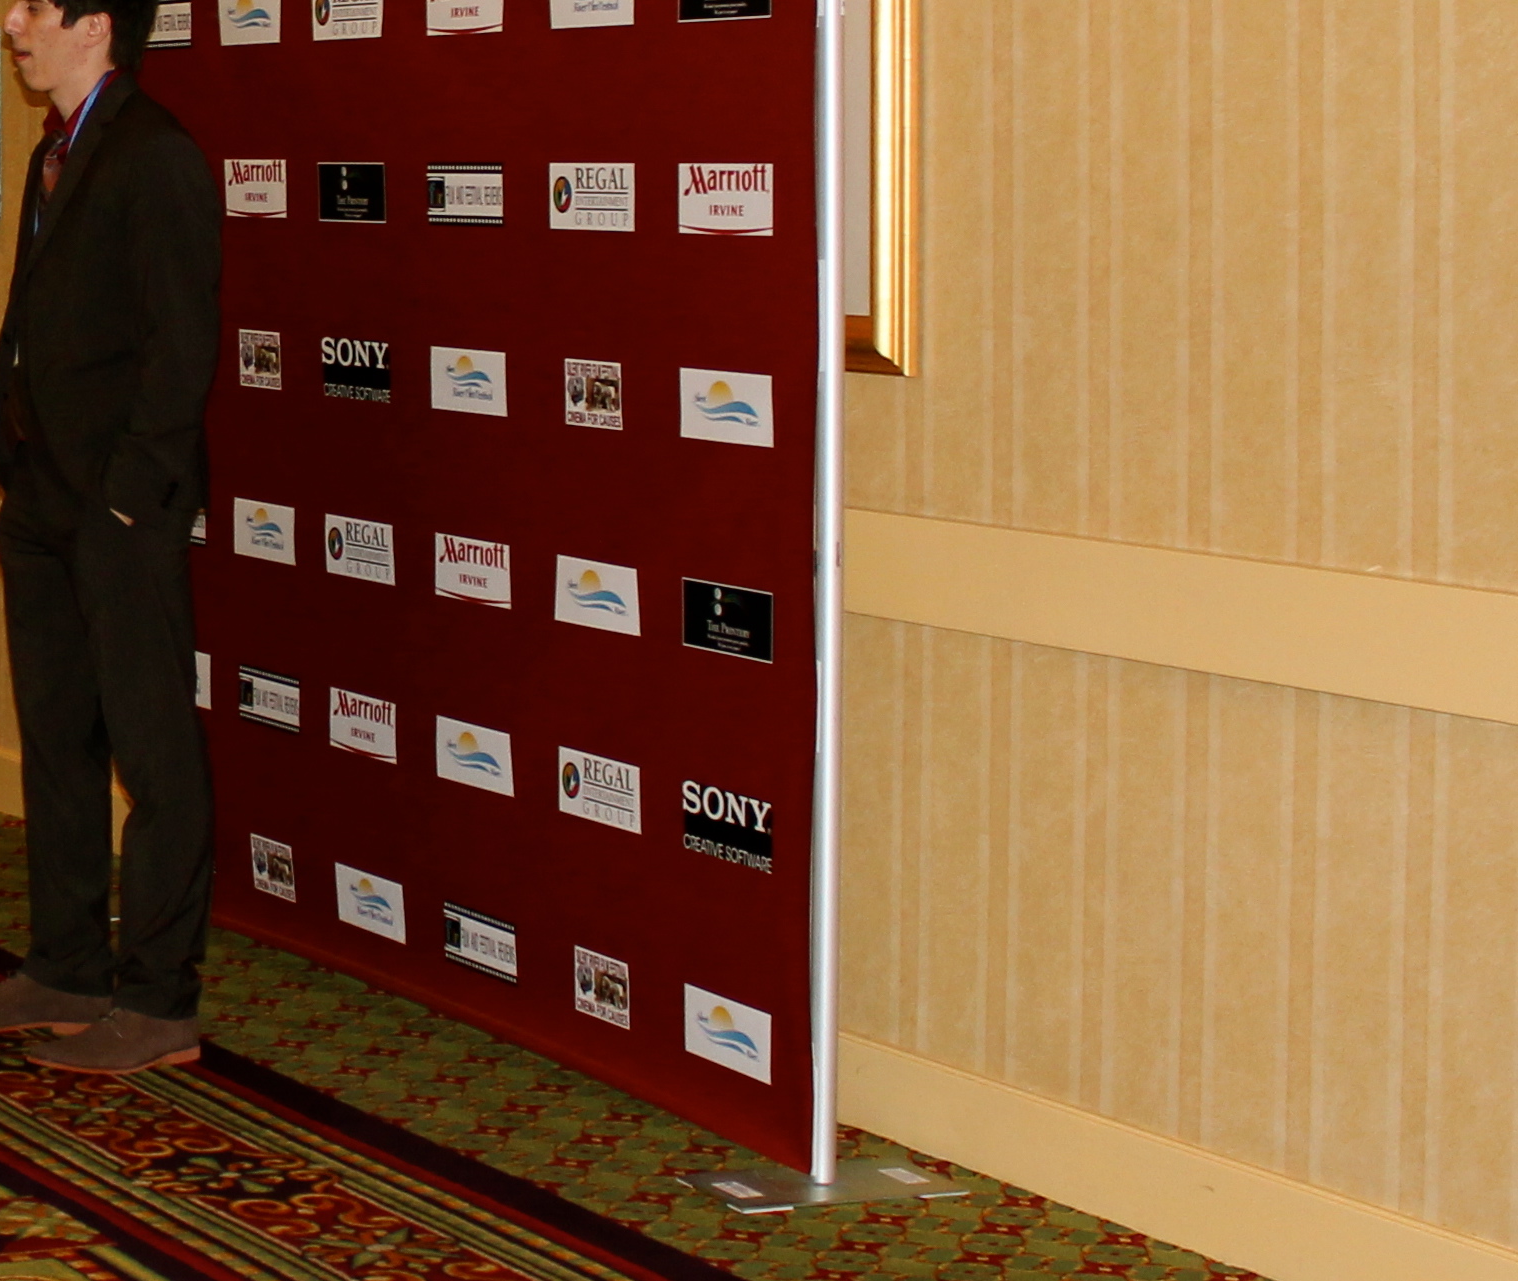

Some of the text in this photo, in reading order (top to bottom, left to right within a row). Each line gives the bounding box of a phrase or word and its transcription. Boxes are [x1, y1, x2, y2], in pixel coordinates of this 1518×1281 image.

[451, 6, 479, 18] IRVINE
[333, 21, 377, 37] GROUP
[228, 161, 283, 186] Marriott
[576, 168, 629, 190] REGAL
[684, 165, 766, 196] Marriott
[576, 212, 629, 226] GROUP
[710, 205, 744, 216] IRVINE
[322, 337, 388, 369] SONY
[346, 522, 389, 548] REGAL
[439, 536, 505, 569] Marriott
[346, 561, 390, 581] GROUP
[460, 574, 487, 588] IRVINE
[334, 691, 392, 726] Marriott
[583, 757, 634, 792] REGAL
[583, 803, 635, 828] GROUP
[683, 781, 771, 833] SONY
[684, 834, 772, 874] CREATIVE SOFTWARE
